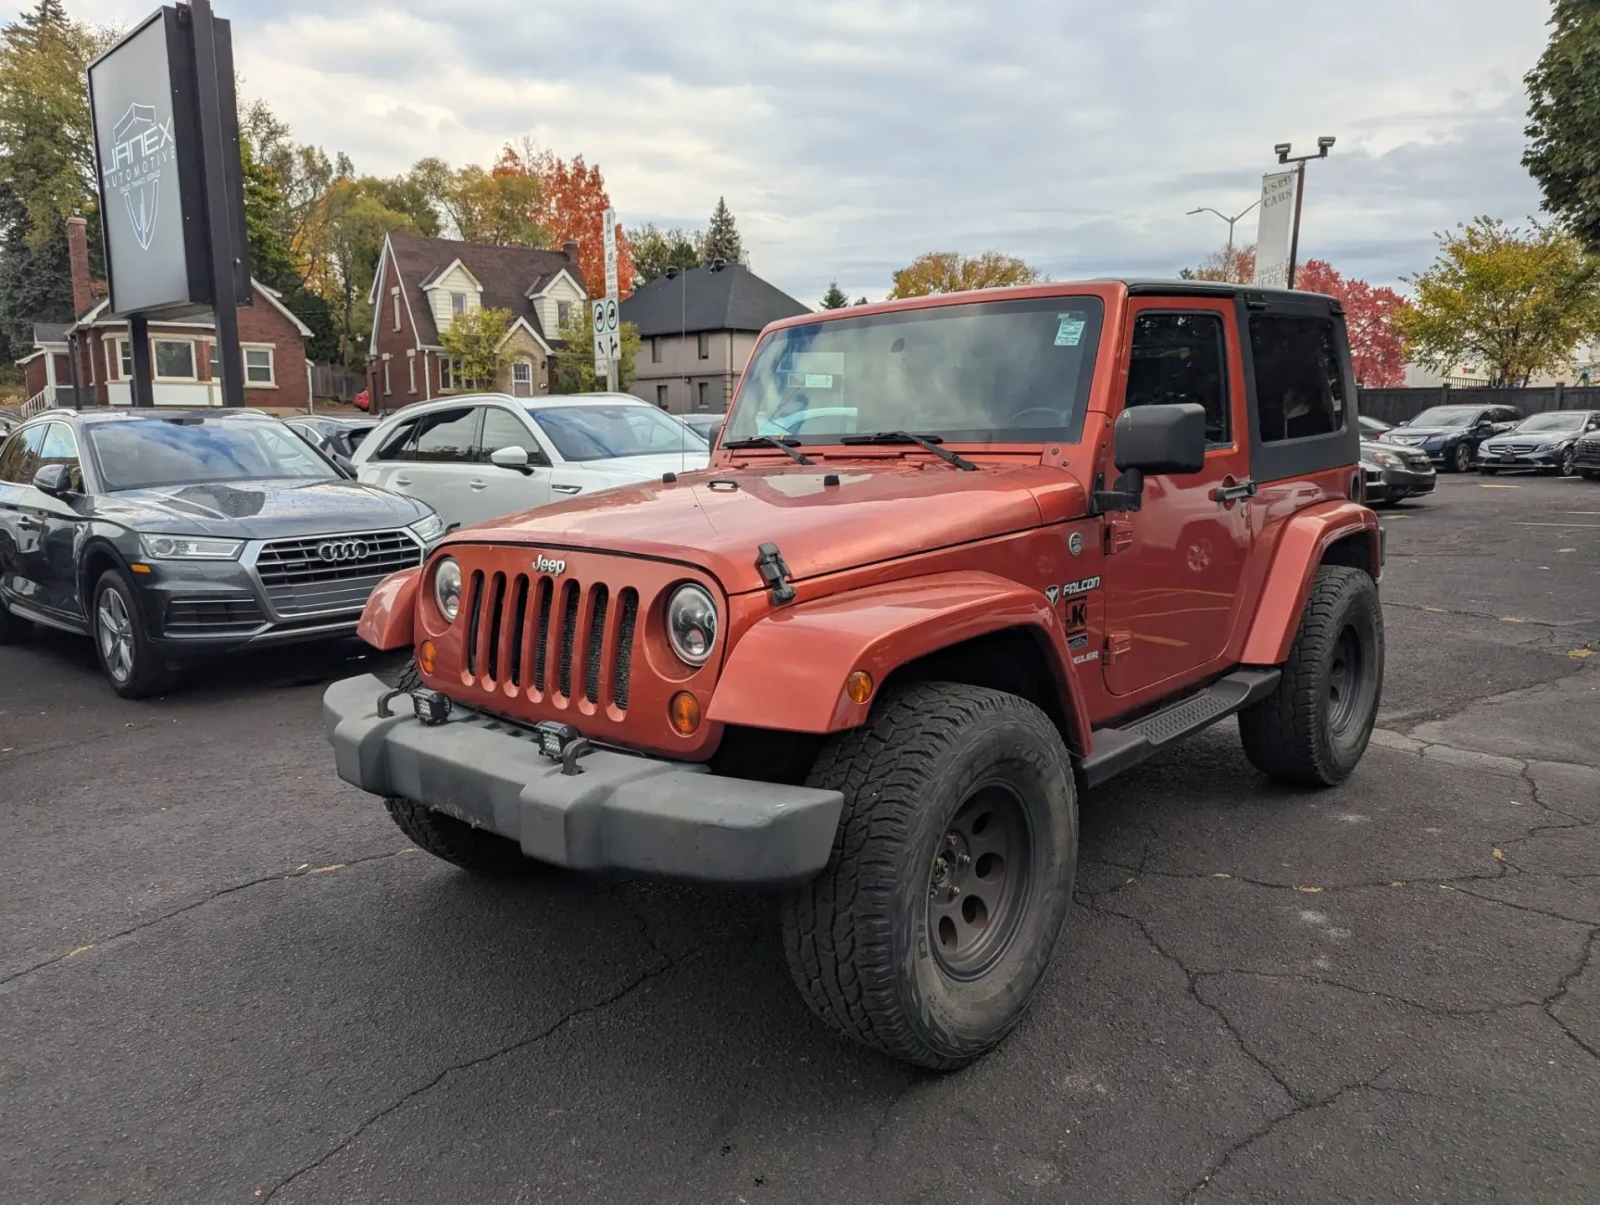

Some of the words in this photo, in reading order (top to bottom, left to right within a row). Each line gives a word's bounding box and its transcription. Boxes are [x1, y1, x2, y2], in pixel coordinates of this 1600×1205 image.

[102, 116, 173, 176] JANEX
[104, 145, 176, 191] AUTOMOTIVE
[1263, 174, 1292, 195] USED
[1263, 188, 1293, 208] CARS
[532, 554, 566, 577] Jeep
[1062, 575, 1100, 597] FALCON
[1066, 602, 1087, 627] JK
[1073, 651, 1099, 664] GLER
